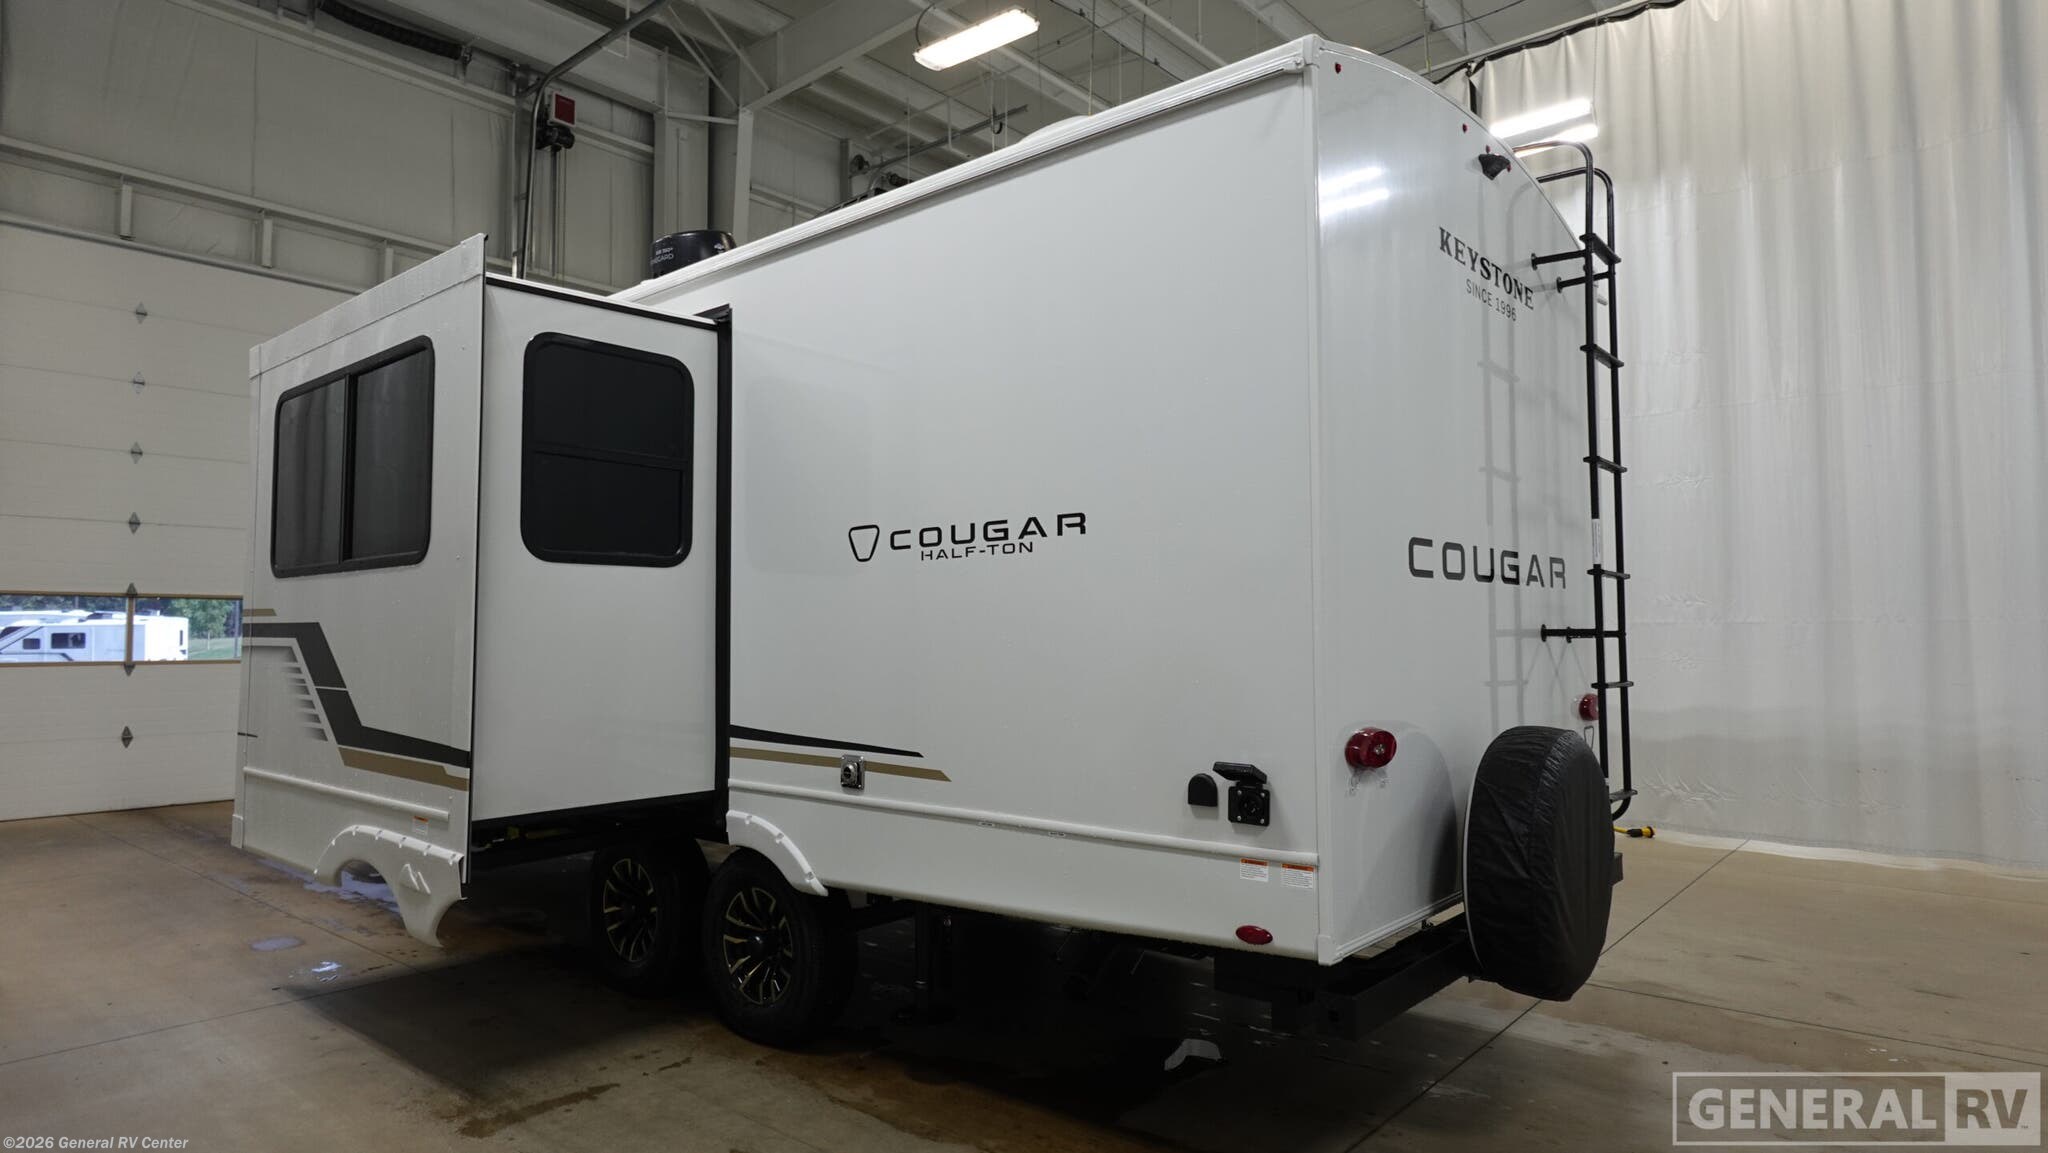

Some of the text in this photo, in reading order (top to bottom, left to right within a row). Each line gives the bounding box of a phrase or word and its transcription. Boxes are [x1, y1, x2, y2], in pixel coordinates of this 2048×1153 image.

[1439, 226, 1534, 310] KEYSTONE
[1466, 278, 1517, 322] SINCE 1996
[890, 512, 1086, 551] COUGAR
[920, 541, 1033, 561] HALF-TON
[1408, 537, 1566, 589] COUGAR
